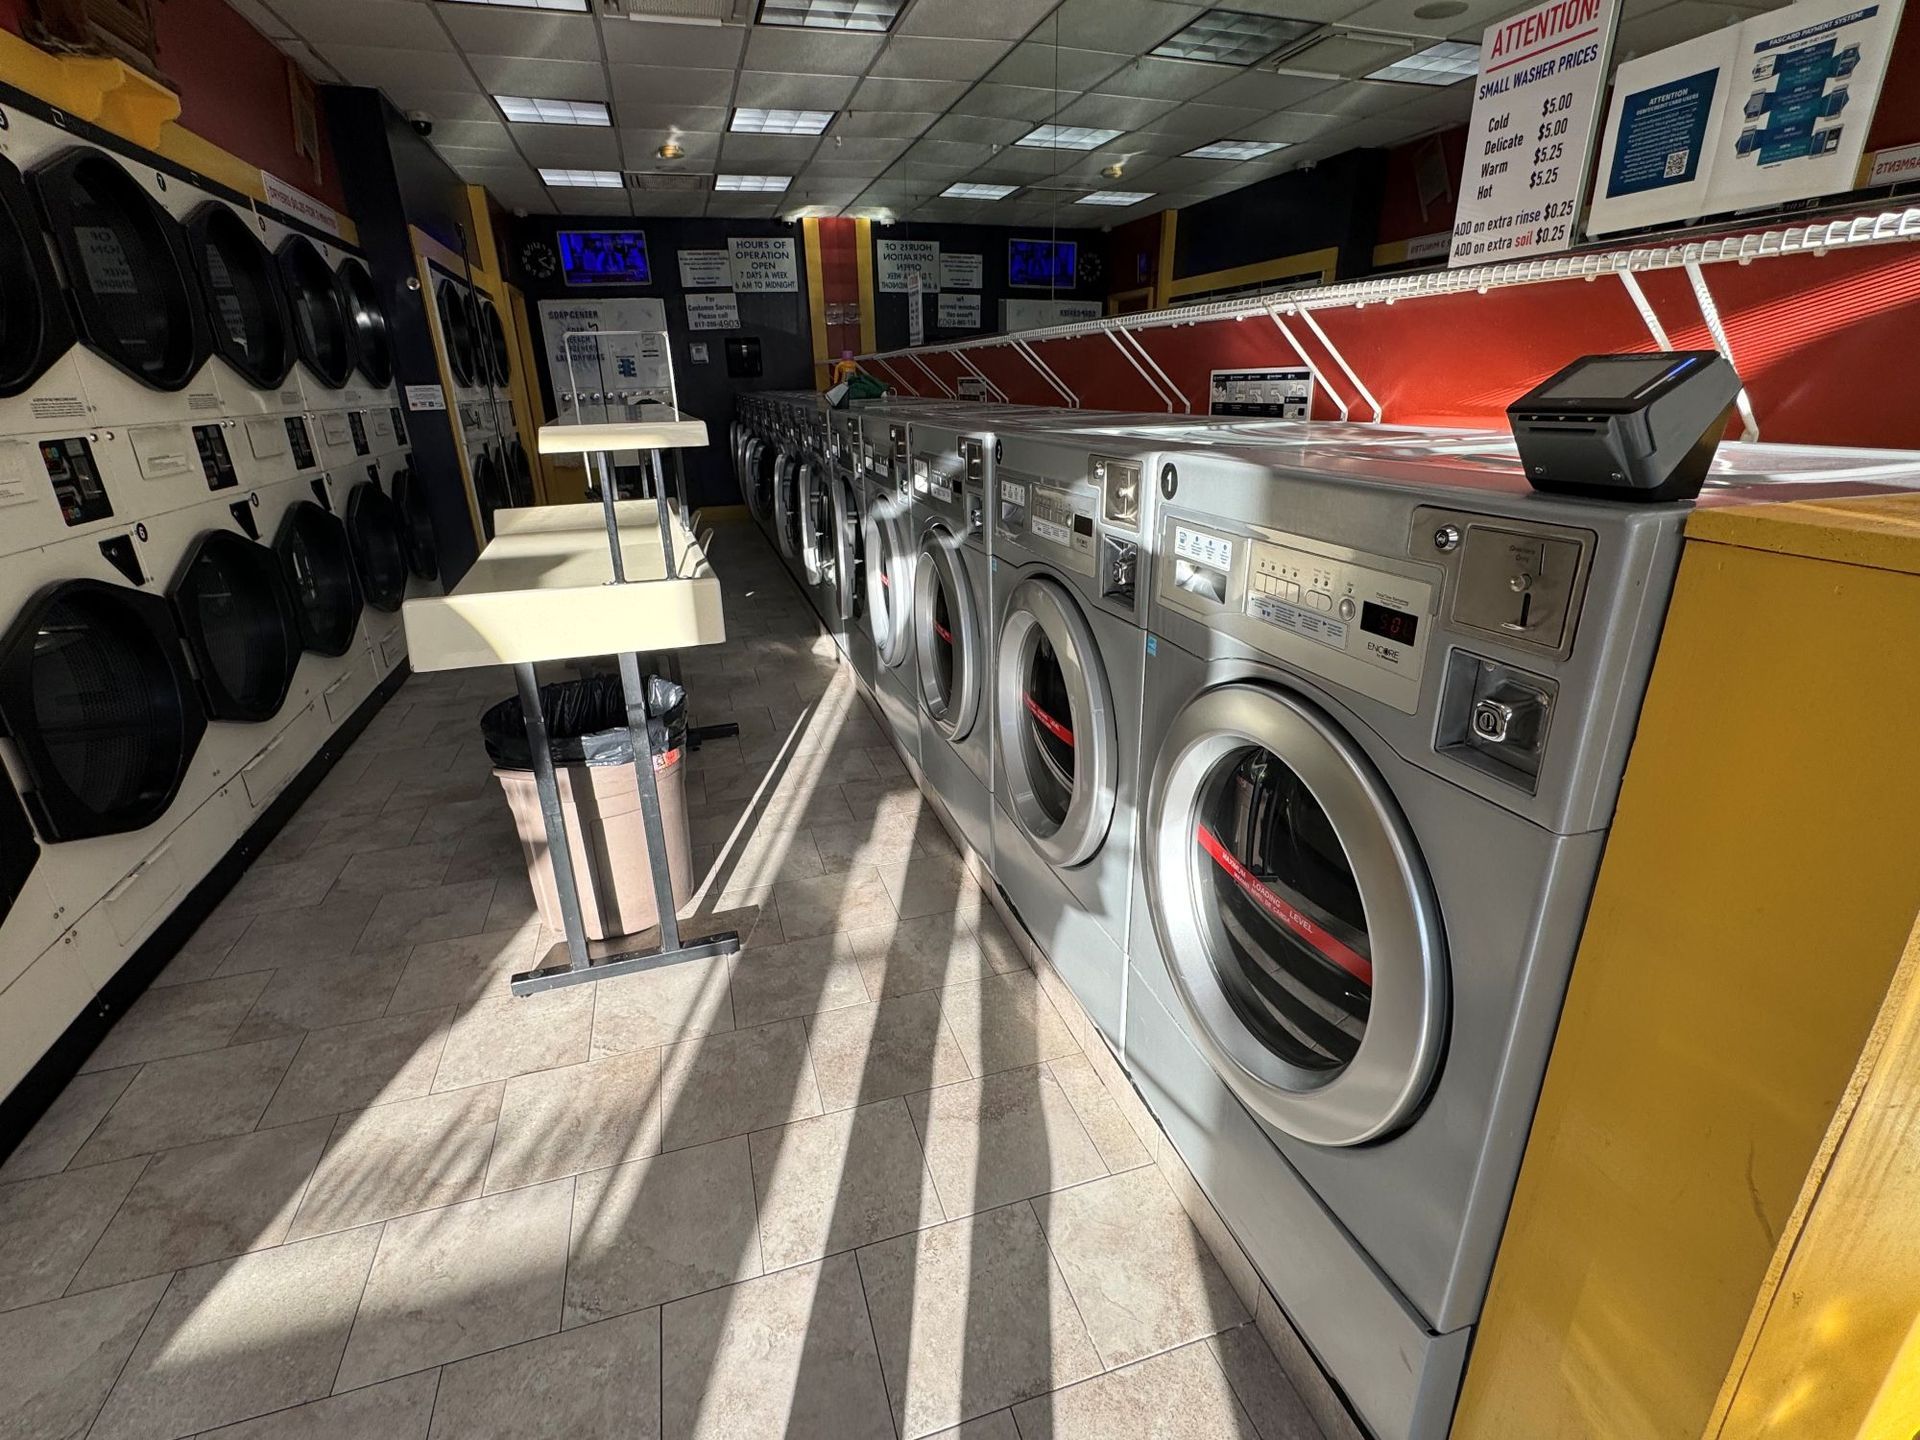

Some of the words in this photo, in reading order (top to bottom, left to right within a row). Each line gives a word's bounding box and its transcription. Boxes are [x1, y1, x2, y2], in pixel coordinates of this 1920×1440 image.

[1491, 0, 1600, 59] ATTENTION!
[1479, 77, 1510, 100] SMALL
[1513, 60, 1555, 88] WASHER
[1558, 44, 1599, 73] PRICES
[1488, 113, 1510, 132] Cold
[1542, 92, 1573, 117] $5.00
[1648, 88, 1688, 106] ATTENTION
[1484, 134, 1524, 155] Delicate
[1539, 118, 1568, 141] $5.00
[1481, 161, 1508, 178] Warm
[1534, 143, 1563, 165] $5.25
[1477, 184, 1492, 200] Hot
[1529, 167, 1559, 189] $5.25
[1454, 221, 1471, 237] ADD
[1474, 223, 1484, 234] on
[1487, 214, 1512, 230] extra
[1515, 210, 1541, 226] rinse
[1544, 200, 1574, 221] $0.25
[735, 251, 789, 260] OPERATION
[736, 241, 770, 249] HOURS
[773, 241, 786, 249] OF
[1454, 242, 1471, 257] ADD
[1474, 243, 1484, 254] on
[1487, 235, 1512, 251] extra
[1514, 230, 1533, 248] soil
[1535, 225, 1565, 245] $0.25
[751, 262, 776, 270] OPEN
[742, 281, 752, 289] AM
[754, 281, 763, 289] TO
[765, 281, 795, 289] MIDNIGHT
[1368, 642, 1400, 659] ENCORE
[1222, 852, 1247, 877] MAXIMUM
[1252, 880, 1282, 907] LOADING
[1289, 911, 1313, 933] LEVEL
